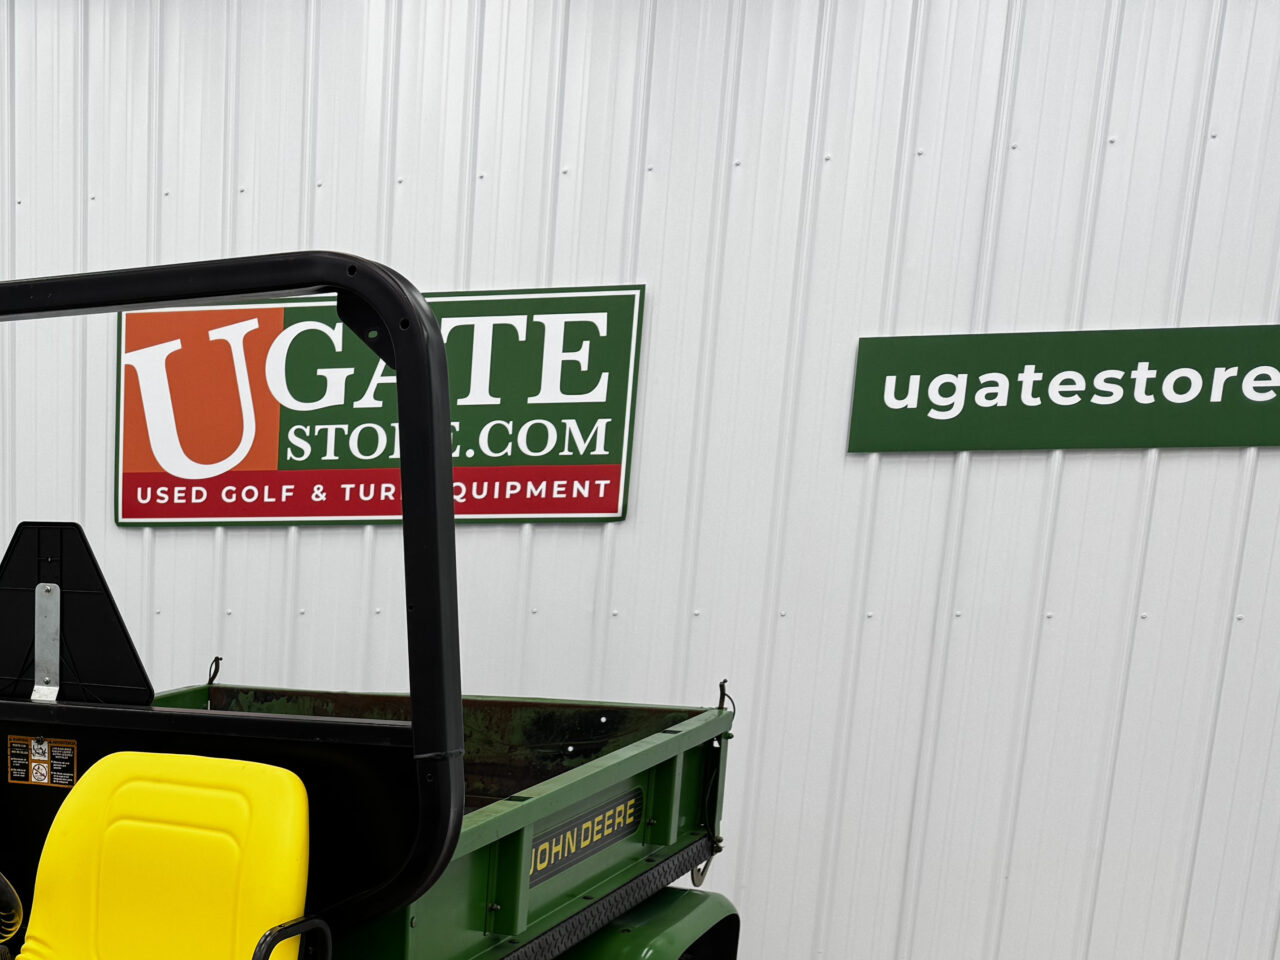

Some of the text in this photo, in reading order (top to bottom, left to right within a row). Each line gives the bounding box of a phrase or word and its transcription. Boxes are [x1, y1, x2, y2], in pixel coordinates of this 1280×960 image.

[883, 361, 1280, 420] ugatestore
[137, 479, 611, 504] USED GOLF & TUR QUIPMENT
[529, 799, 635, 876] JOHN DEERE
